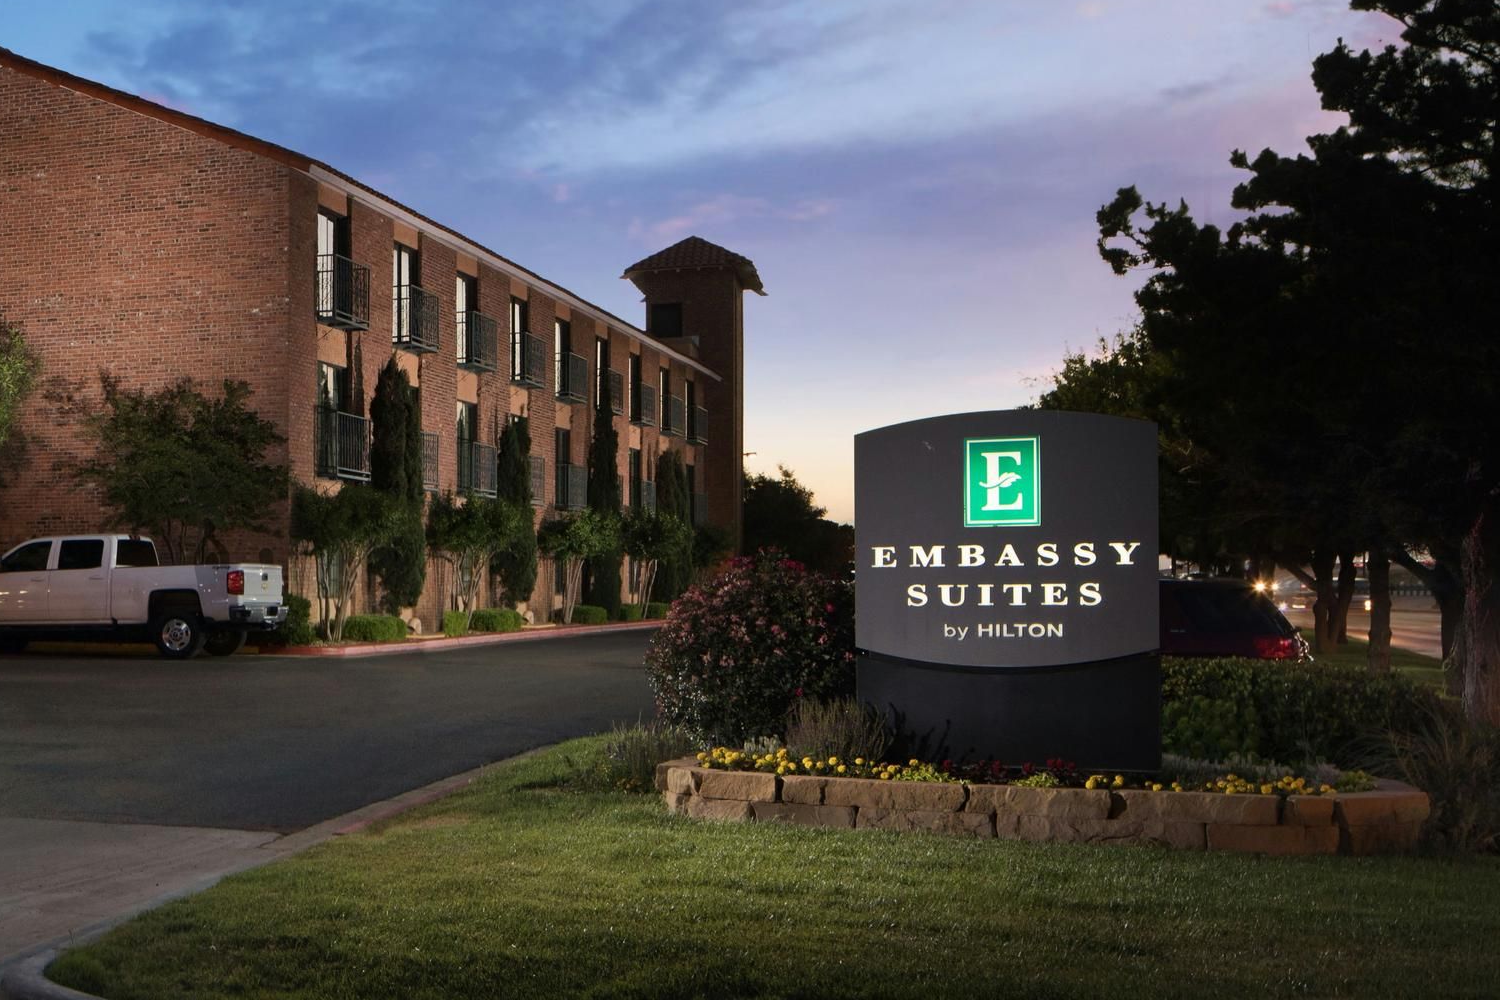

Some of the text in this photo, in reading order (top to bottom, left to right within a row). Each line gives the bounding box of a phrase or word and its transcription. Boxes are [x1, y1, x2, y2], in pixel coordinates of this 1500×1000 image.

[979, 451, 1023, 511] E
[871, 542, 1141, 568] EMBASSY
[907, 582, 1102, 607] SUITES
[943, 623, 1063, 641] by HILTON
